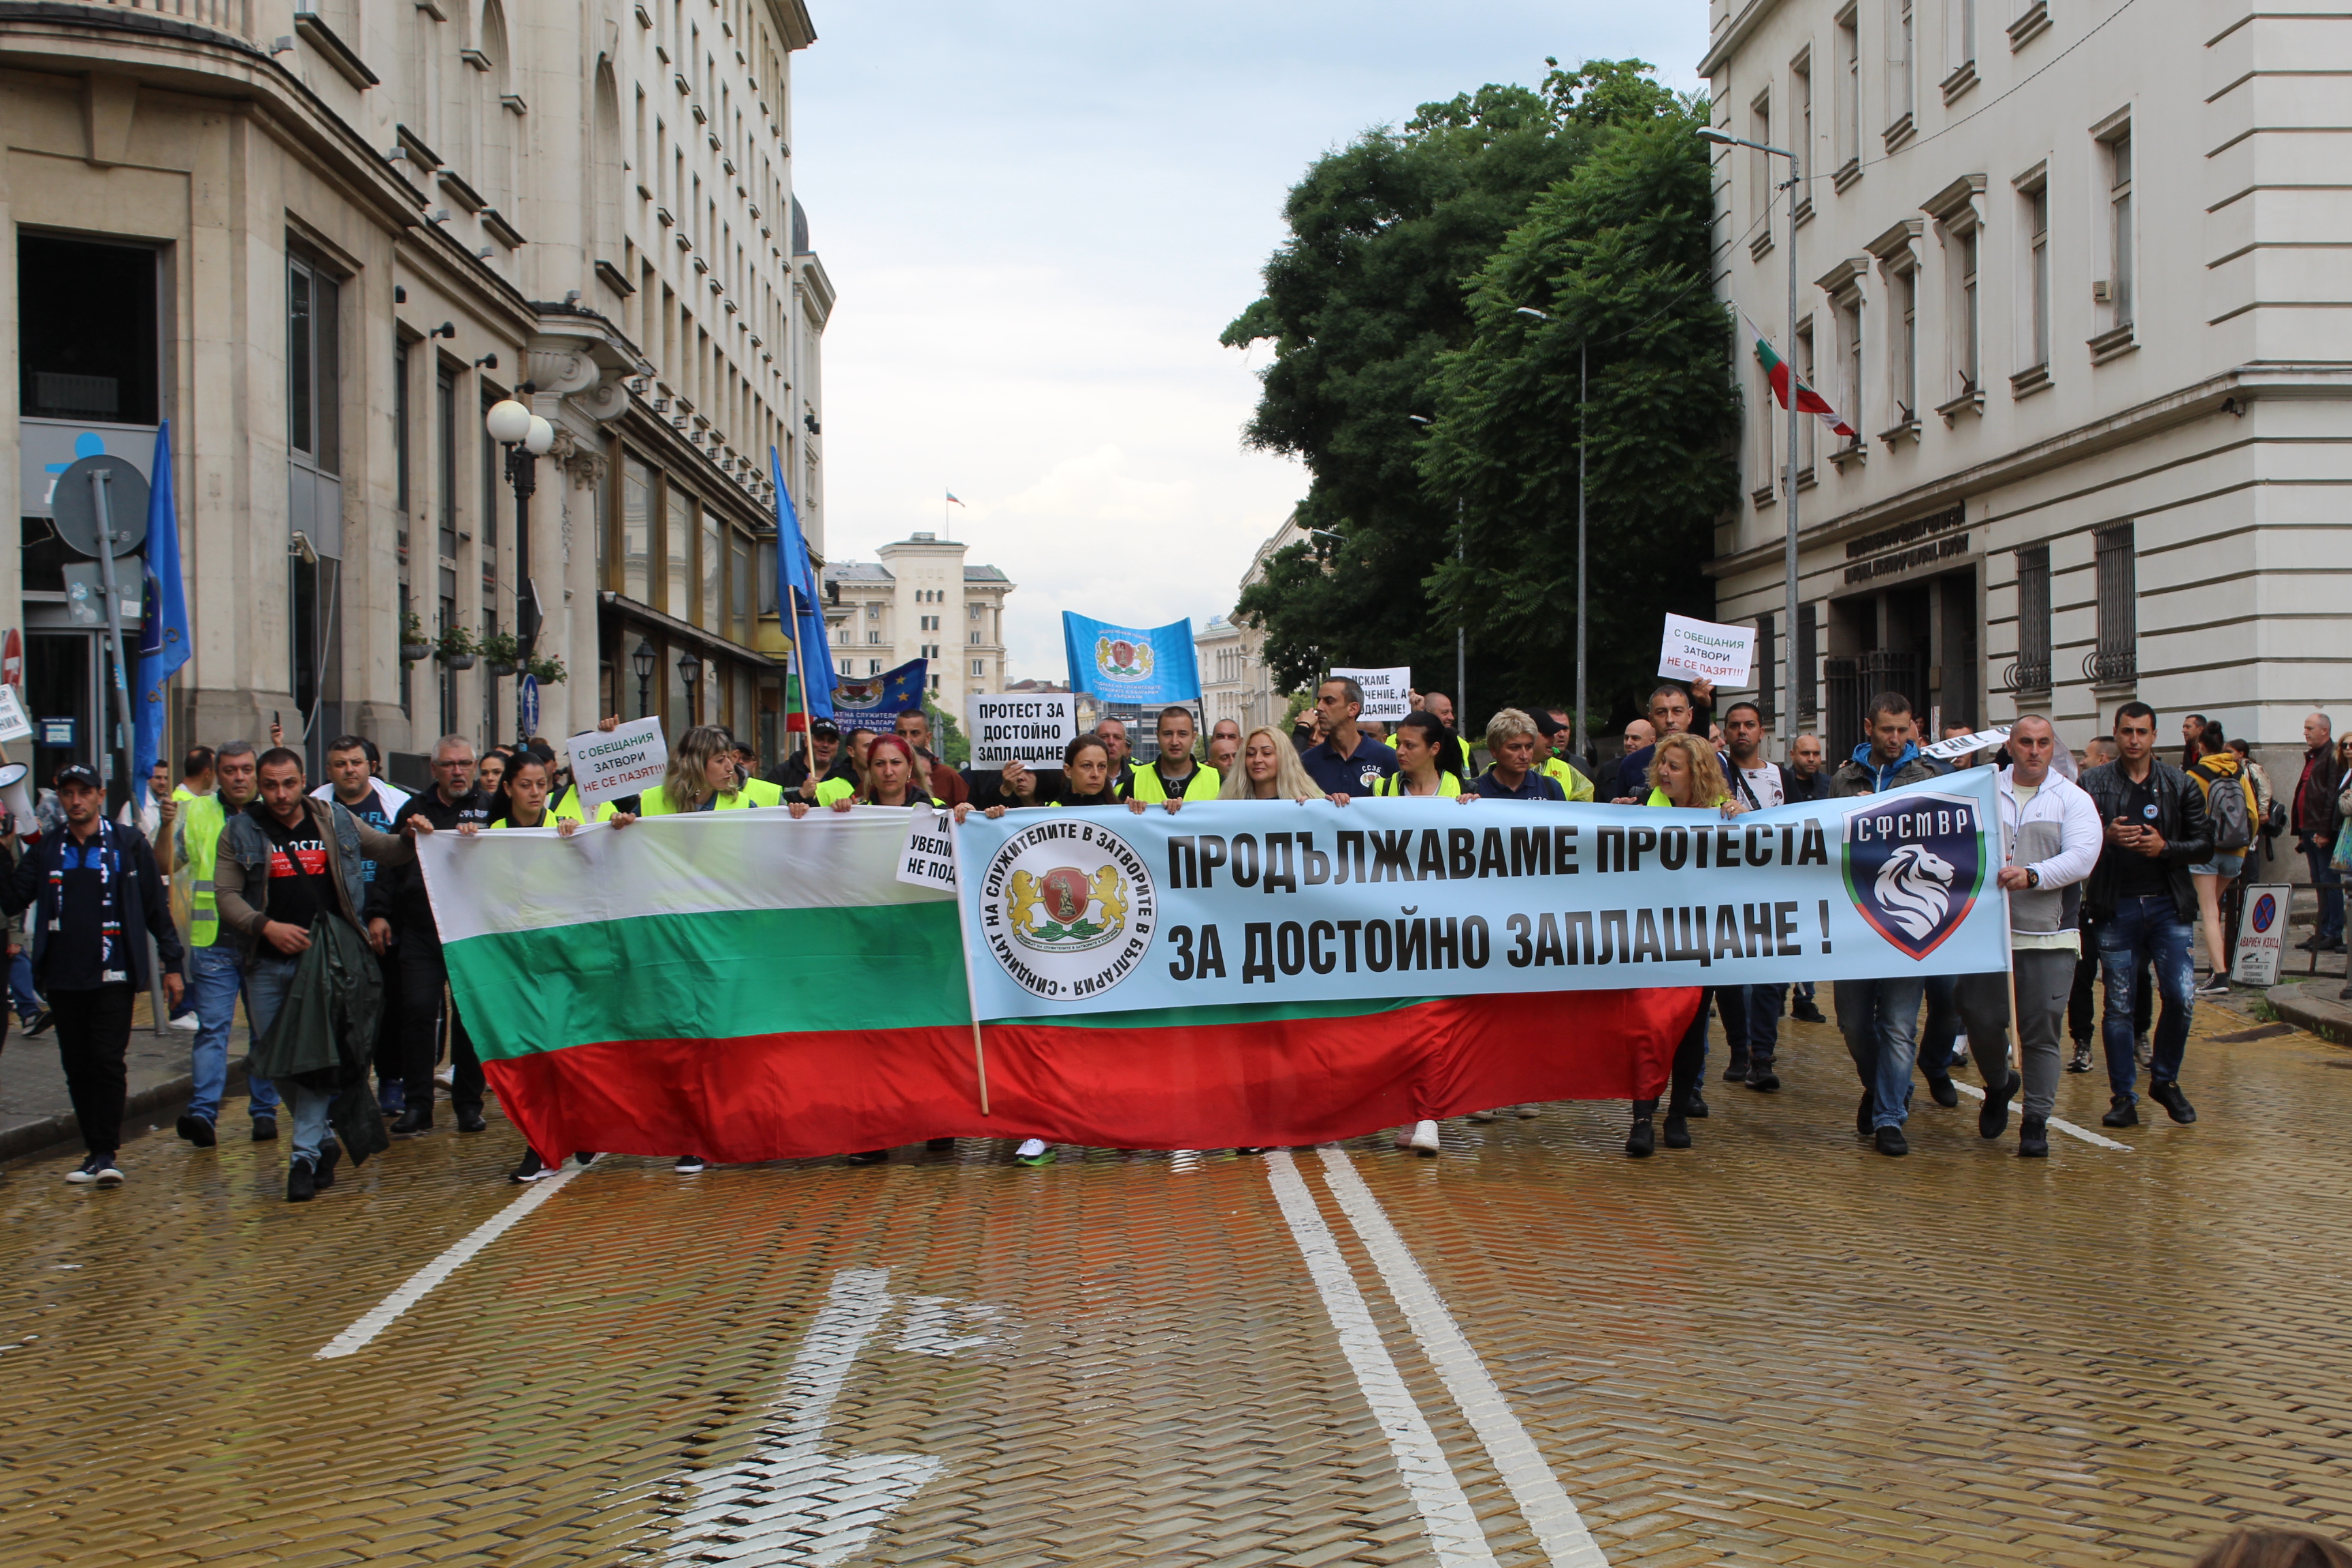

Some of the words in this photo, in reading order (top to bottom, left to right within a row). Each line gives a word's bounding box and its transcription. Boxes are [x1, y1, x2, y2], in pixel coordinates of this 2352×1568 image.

[1674, 629, 1681, 637] С
[1684, 631, 1744, 649] ОБЕЩАНИЯ
[1684, 644, 1730, 662] ЗАТВОРИ
[1667, 656, 1682, 666] НЕ
[1684, 659, 1697, 670] СЕ
[1699, 664, 1744, 676] ПАЗЯТ!!!
[1363, 689, 1399, 700] ЧЕНИЕ,
[1401, 689, 1407, 699] А
[979, 703, 1042, 719] ПРОТЕСТ
[1047, 703, 1064, 718] ЗА
[983, 722, 1060, 742] ДОСТОЙНО
[578, 751, 586, 760] С
[589, 732, 654, 757] ОБЕЩАНИЯ
[595, 751, 646, 772] ЗАТВОРИ
[583, 781, 599, 793] НЕ
[601, 776, 617, 788] СЕ
[620, 763, 666, 784] ПАЗЯТ!!!
[938, 817, 950, 834] И
[1082, 826, 1093, 841] В
[1858, 808, 1967, 841] СФСМВР
[907, 857, 926, 875] НЕ
[986, 823, 1077, 898] СЛУЖИТЕЛИТЕ
[1168, 826, 1579, 894] ПРОДЪЛЖАВАМЕ
[1597, 818, 1829, 873] ПРОТЕСТА
[1096, 832, 1152, 916] ЗАТВОРИТЕ
[985, 904, 999, 927] НА
[1136, 922, 1149, 934] В
[1168, 924, 1226, 981] ЗА
[1242, 905, 1490, 984] ДОСТОЙНО
[1506, 901, 1801, 968] ЗАПЛАЩАНЕ
[1818, 900, 1832, 954] !
[2240, 936, 2261, 947] АВАРИЕН
[2263, 936, 2278, 949] ИЗХОД
[990, 933, 1058, 996] СИНДИКАТ
[1073, 937, 1143, 996] БЪЛГАРИЯ
